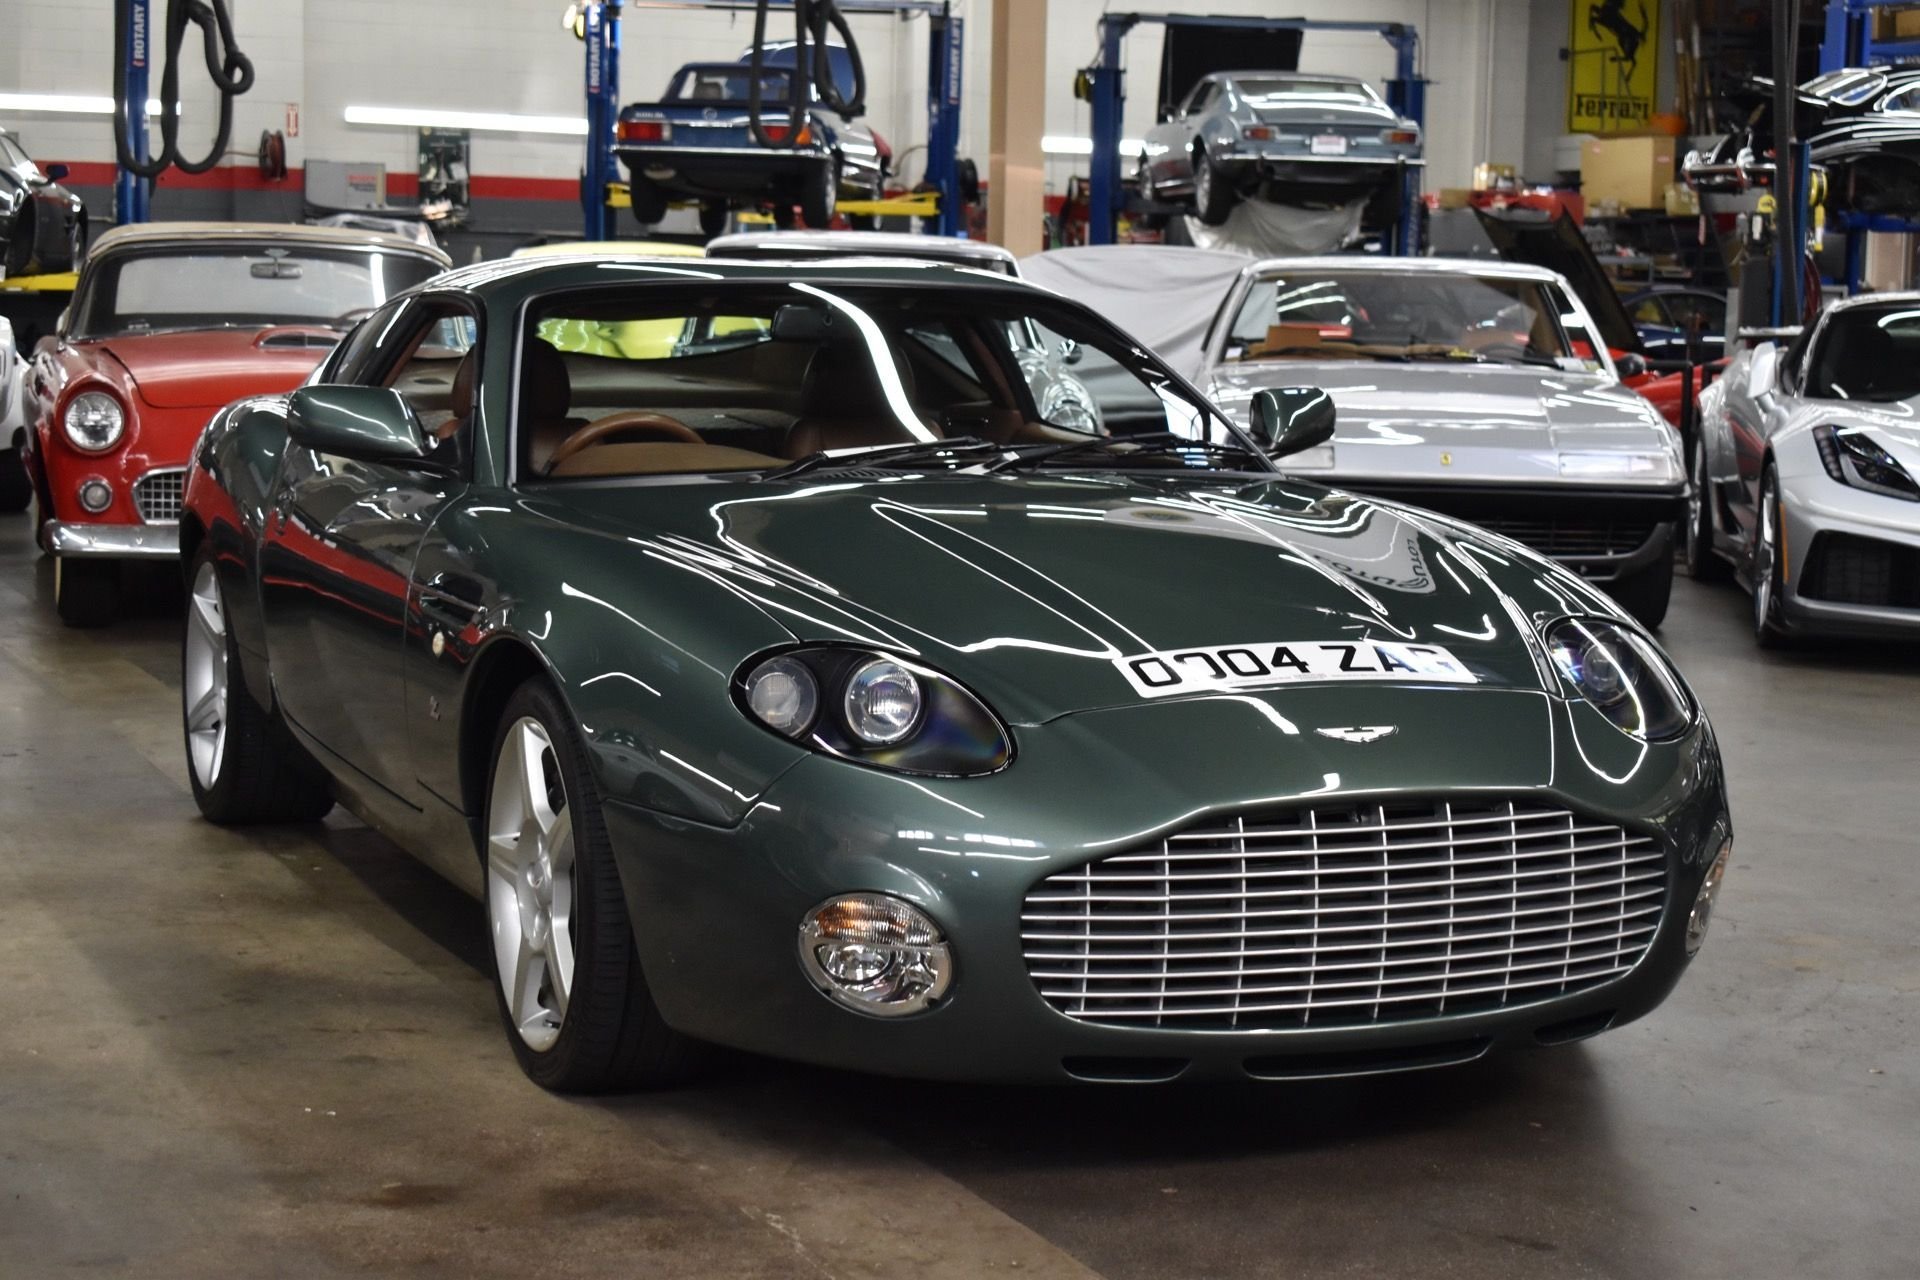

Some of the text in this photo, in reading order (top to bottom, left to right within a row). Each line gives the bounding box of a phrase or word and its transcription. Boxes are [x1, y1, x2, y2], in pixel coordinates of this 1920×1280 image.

[133, 4, 145, 59] ROTARY
[590, 36, 601, 87] ROTARY
[1576, 94, 1649, 119] Ferrari
